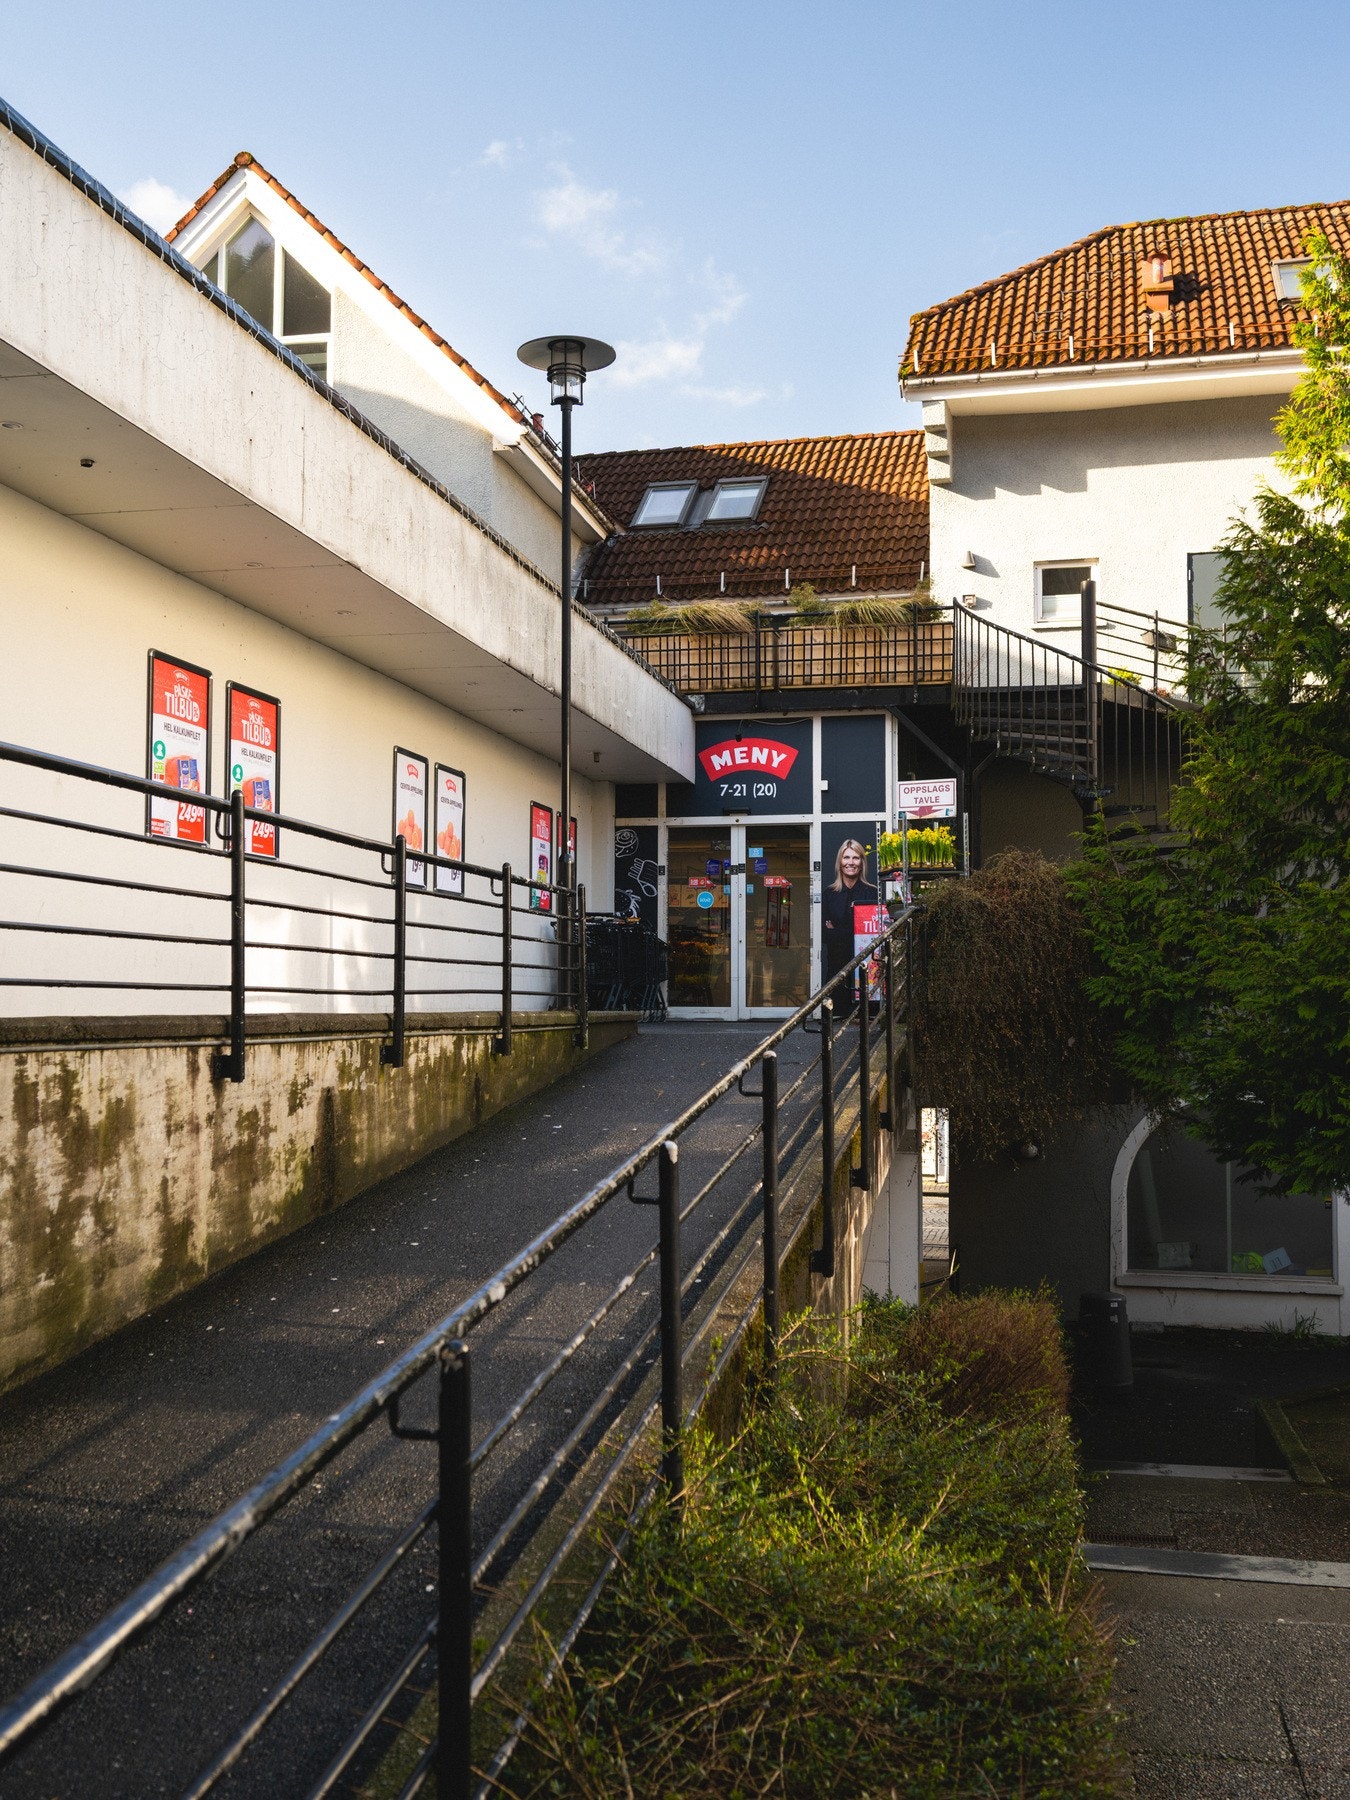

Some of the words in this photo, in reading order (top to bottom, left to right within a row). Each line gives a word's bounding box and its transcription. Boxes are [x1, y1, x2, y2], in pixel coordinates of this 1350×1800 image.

[164, 691, 200, 723] TILBUD
[241, 719, 271, 746] TILBUD
[710, 746, 787, 771] MENY
[720, 784, 747, 796] 7-21
[753, 782, 777, 798] (20)
[903, 784, 951, 795] OPPSLAGS
[914, 795, 940, 805] TAVLE
